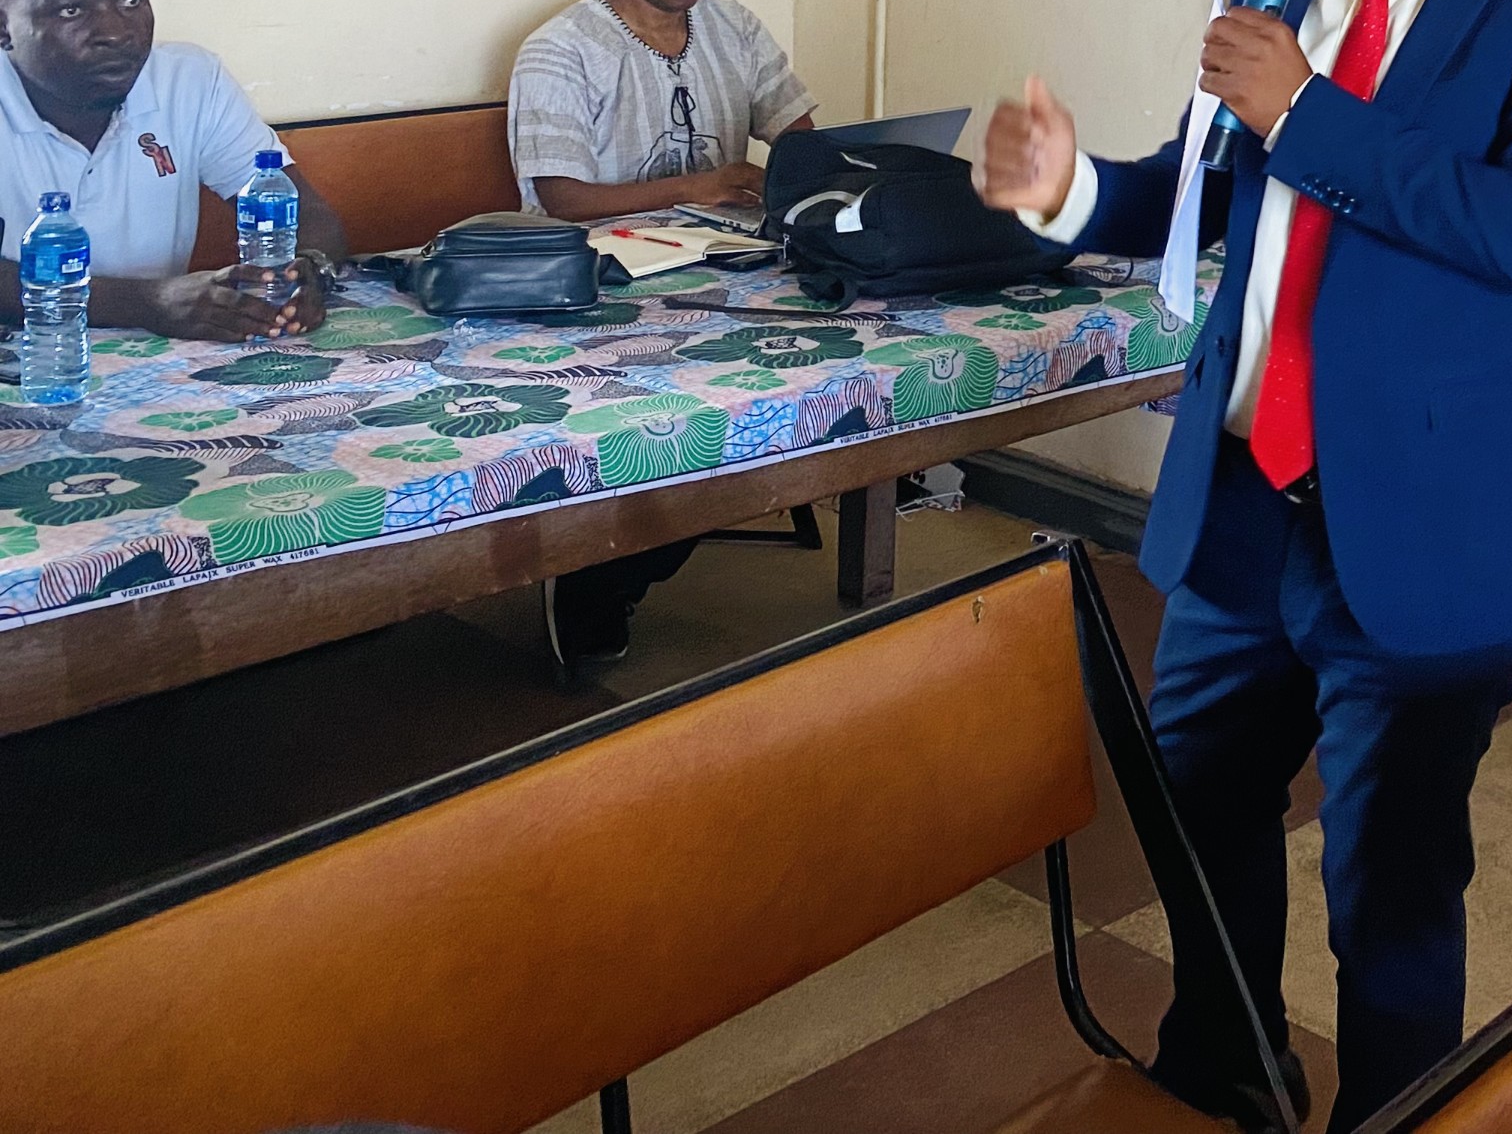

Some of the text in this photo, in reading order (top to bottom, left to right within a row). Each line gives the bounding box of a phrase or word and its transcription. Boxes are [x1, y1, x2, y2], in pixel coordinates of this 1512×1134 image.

[121, 579, 175, 598] VERITABLE
[226, 561, 256, 574] SUPER
[262, 555, 282, 564] WAX
